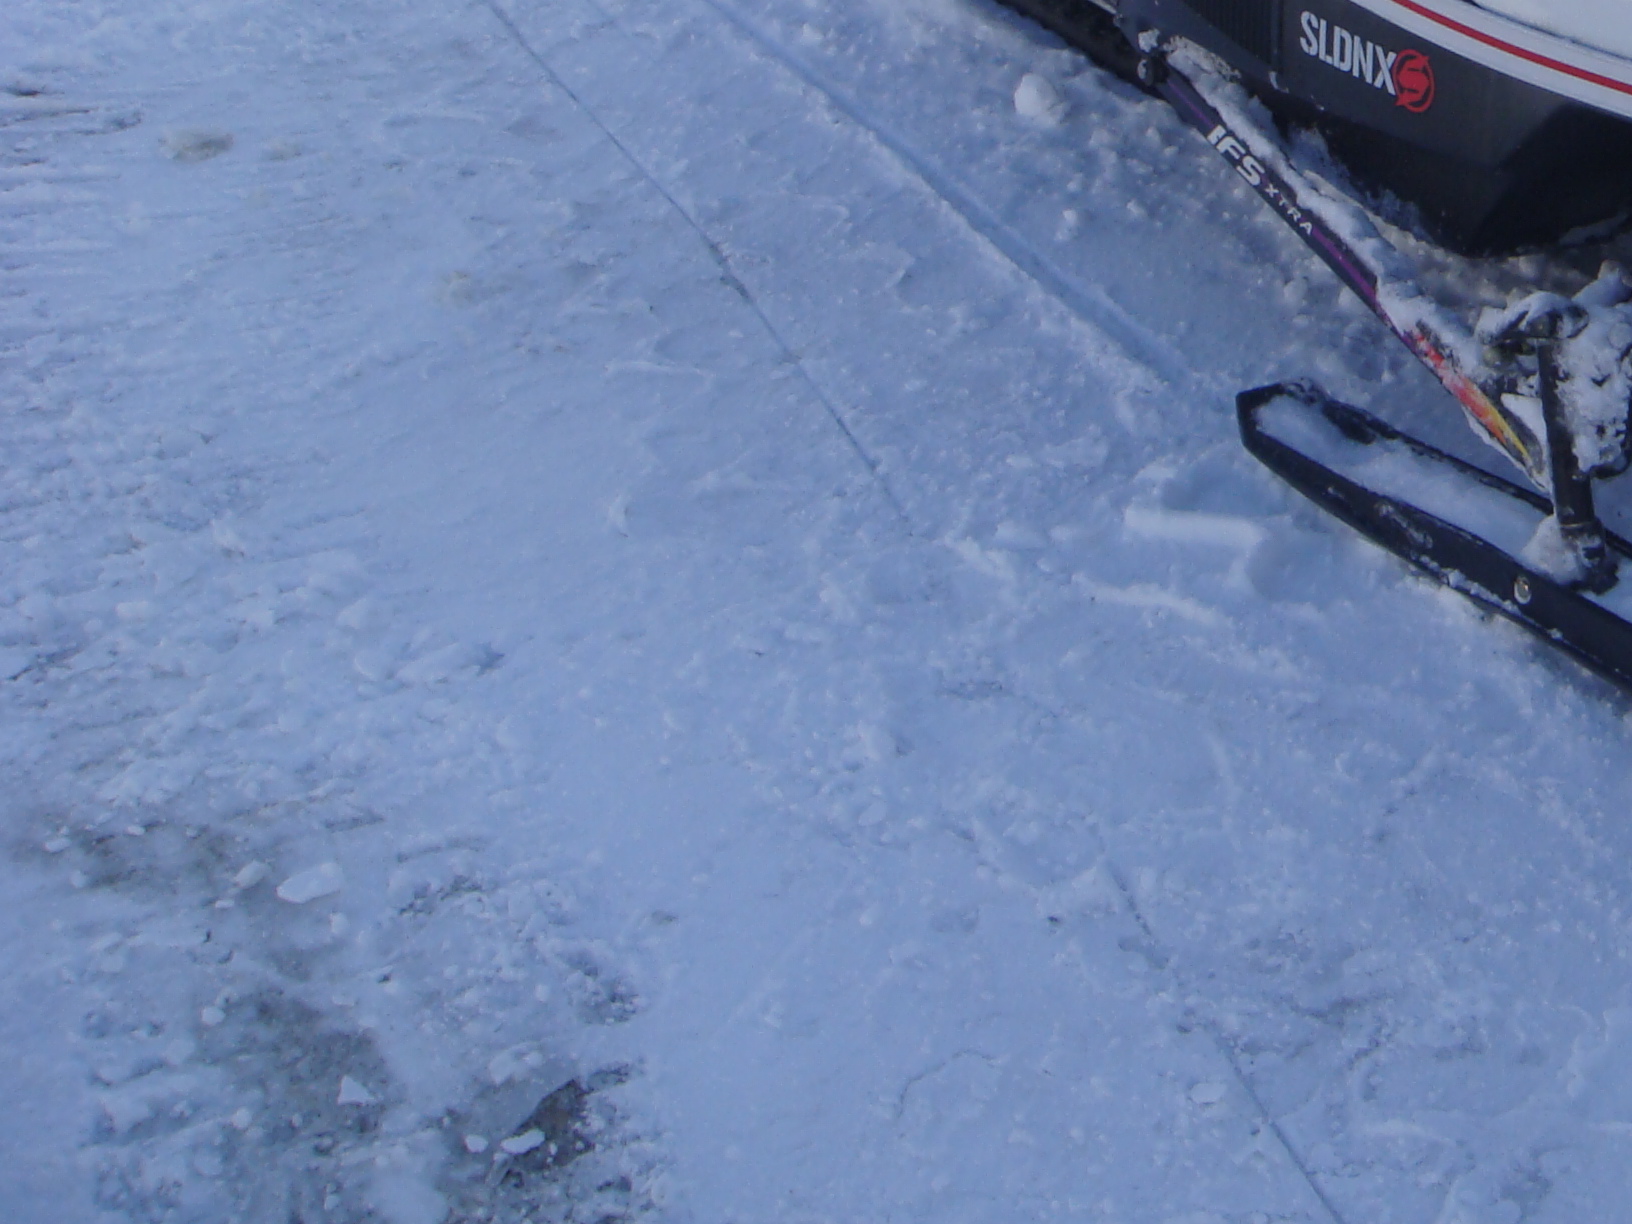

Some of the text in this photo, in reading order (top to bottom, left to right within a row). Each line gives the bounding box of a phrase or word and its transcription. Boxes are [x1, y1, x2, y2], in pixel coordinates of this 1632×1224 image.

[1299, 10, 1398, 96] SLDNX
[1206, 124, 1313, 236] IFS XTRA
